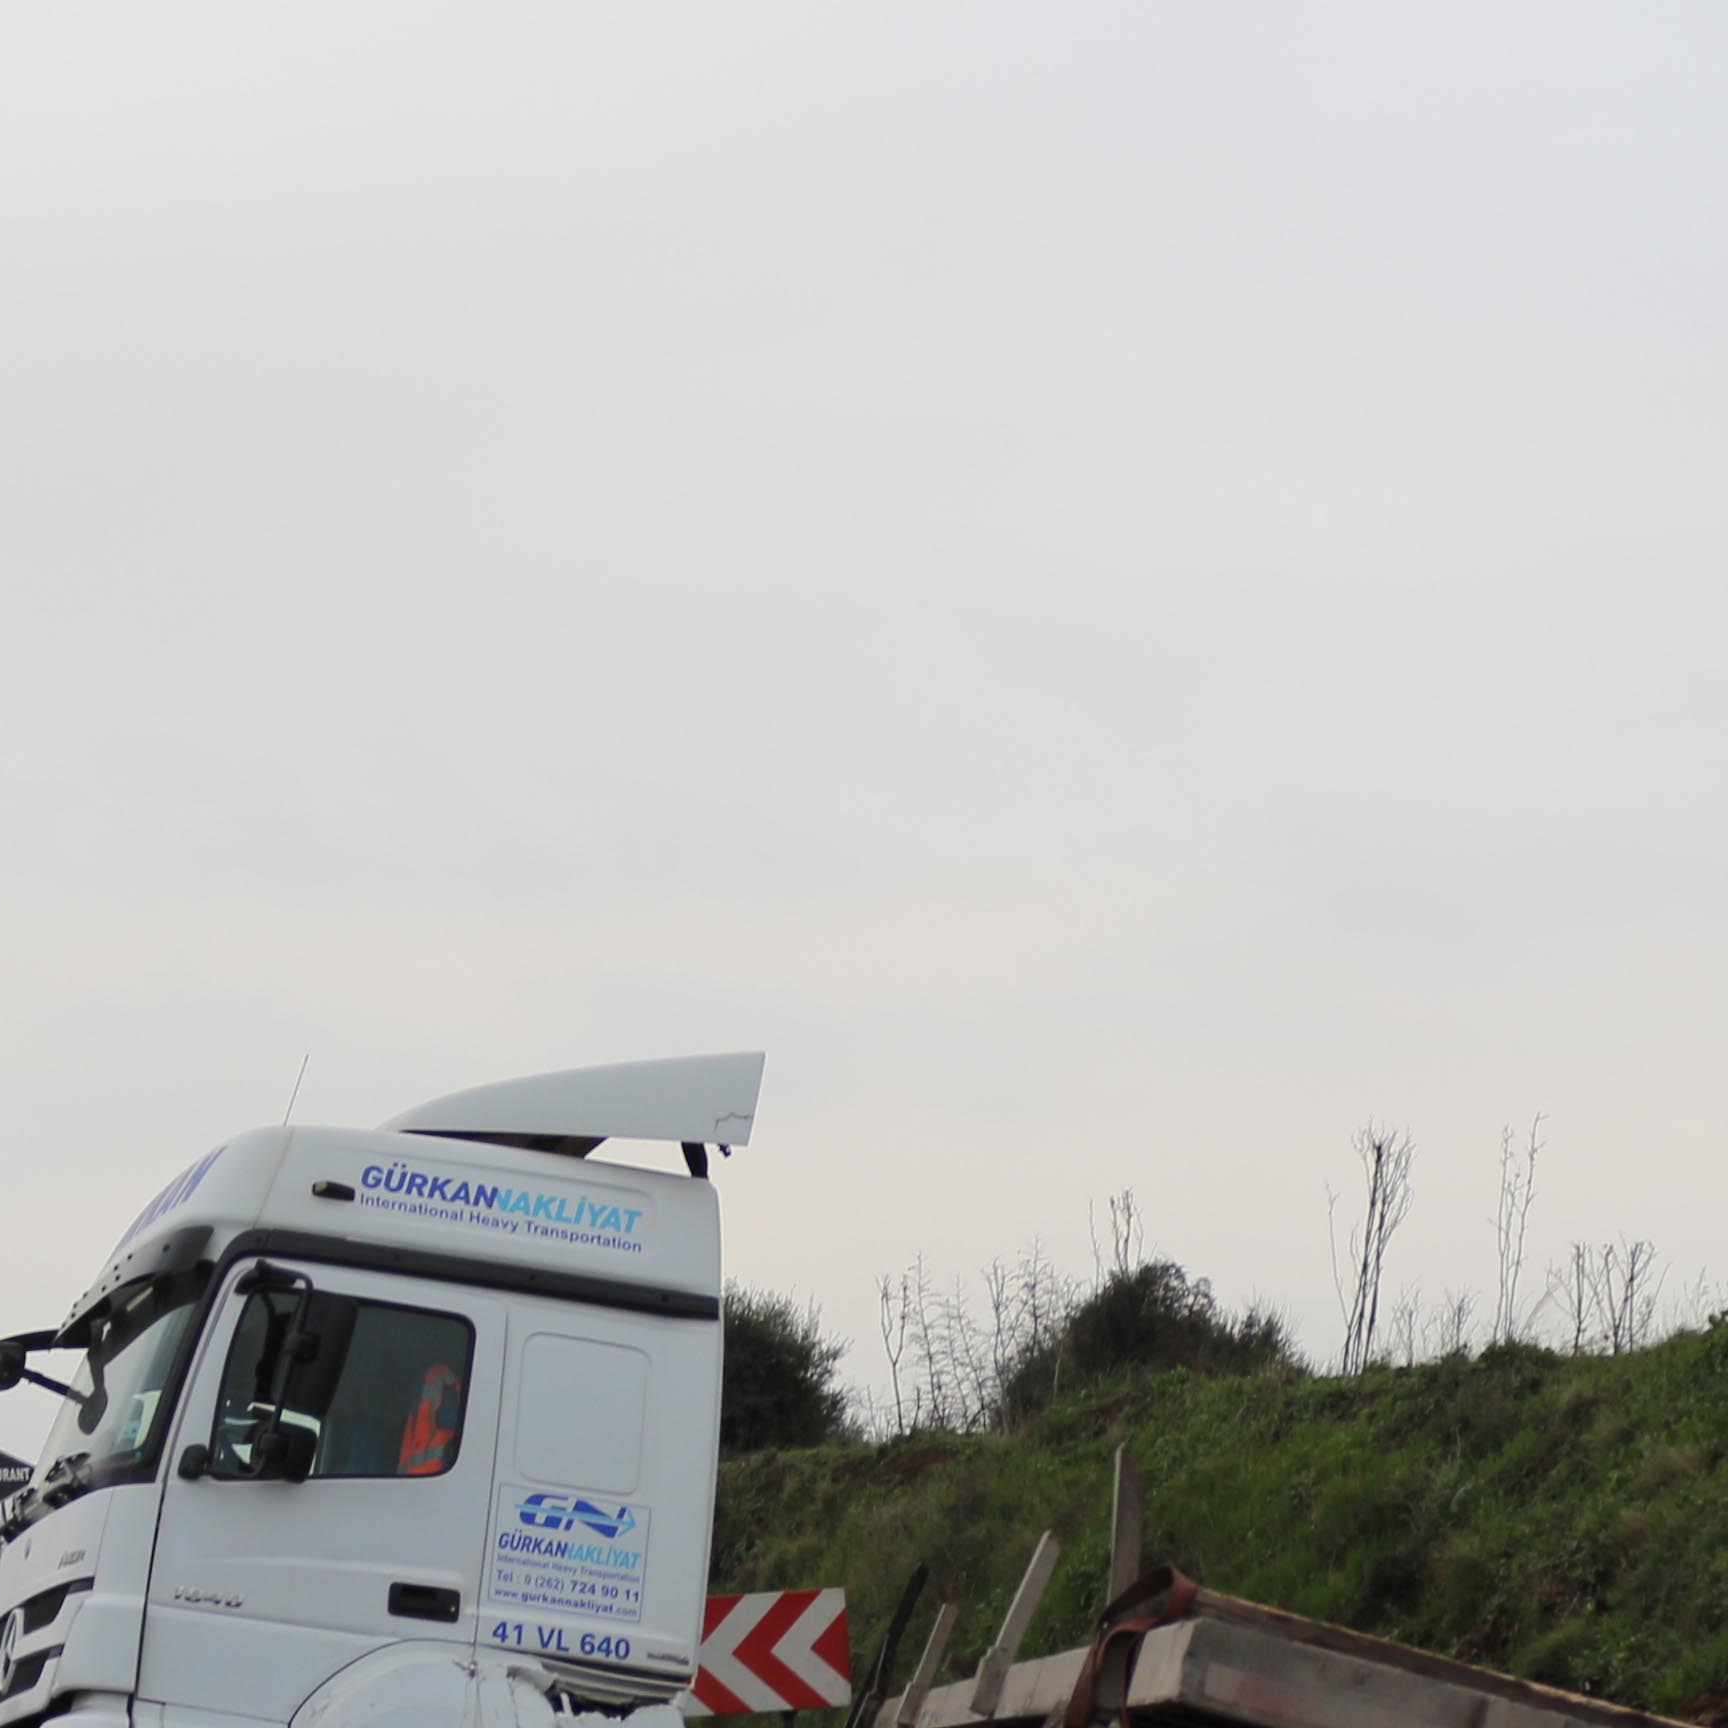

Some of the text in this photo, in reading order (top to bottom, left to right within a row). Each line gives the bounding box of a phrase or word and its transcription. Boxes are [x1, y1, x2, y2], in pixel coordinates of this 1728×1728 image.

[360, 1192, 643, 1252] International Heavy Transportation
[497, 1553, 641, 1583] International Heavy Transportation
[494, 1588, 638, 1617] www.gurkannakliyat.com
[497, 1569, 513, 1583] Tel
[524, 1573, 532, 1585] 0
[535, 1575, 565, 1594] (262)
[570, 1580, 596, 1595] 724
[601, 1585, 618, 1599] 90
[625, 1589, 640, 1603] 11
[492, 1621, 523, 1645] 41
[537, 1625, 569, 1652] VL
[580, 1632, 630, 1661] 640
